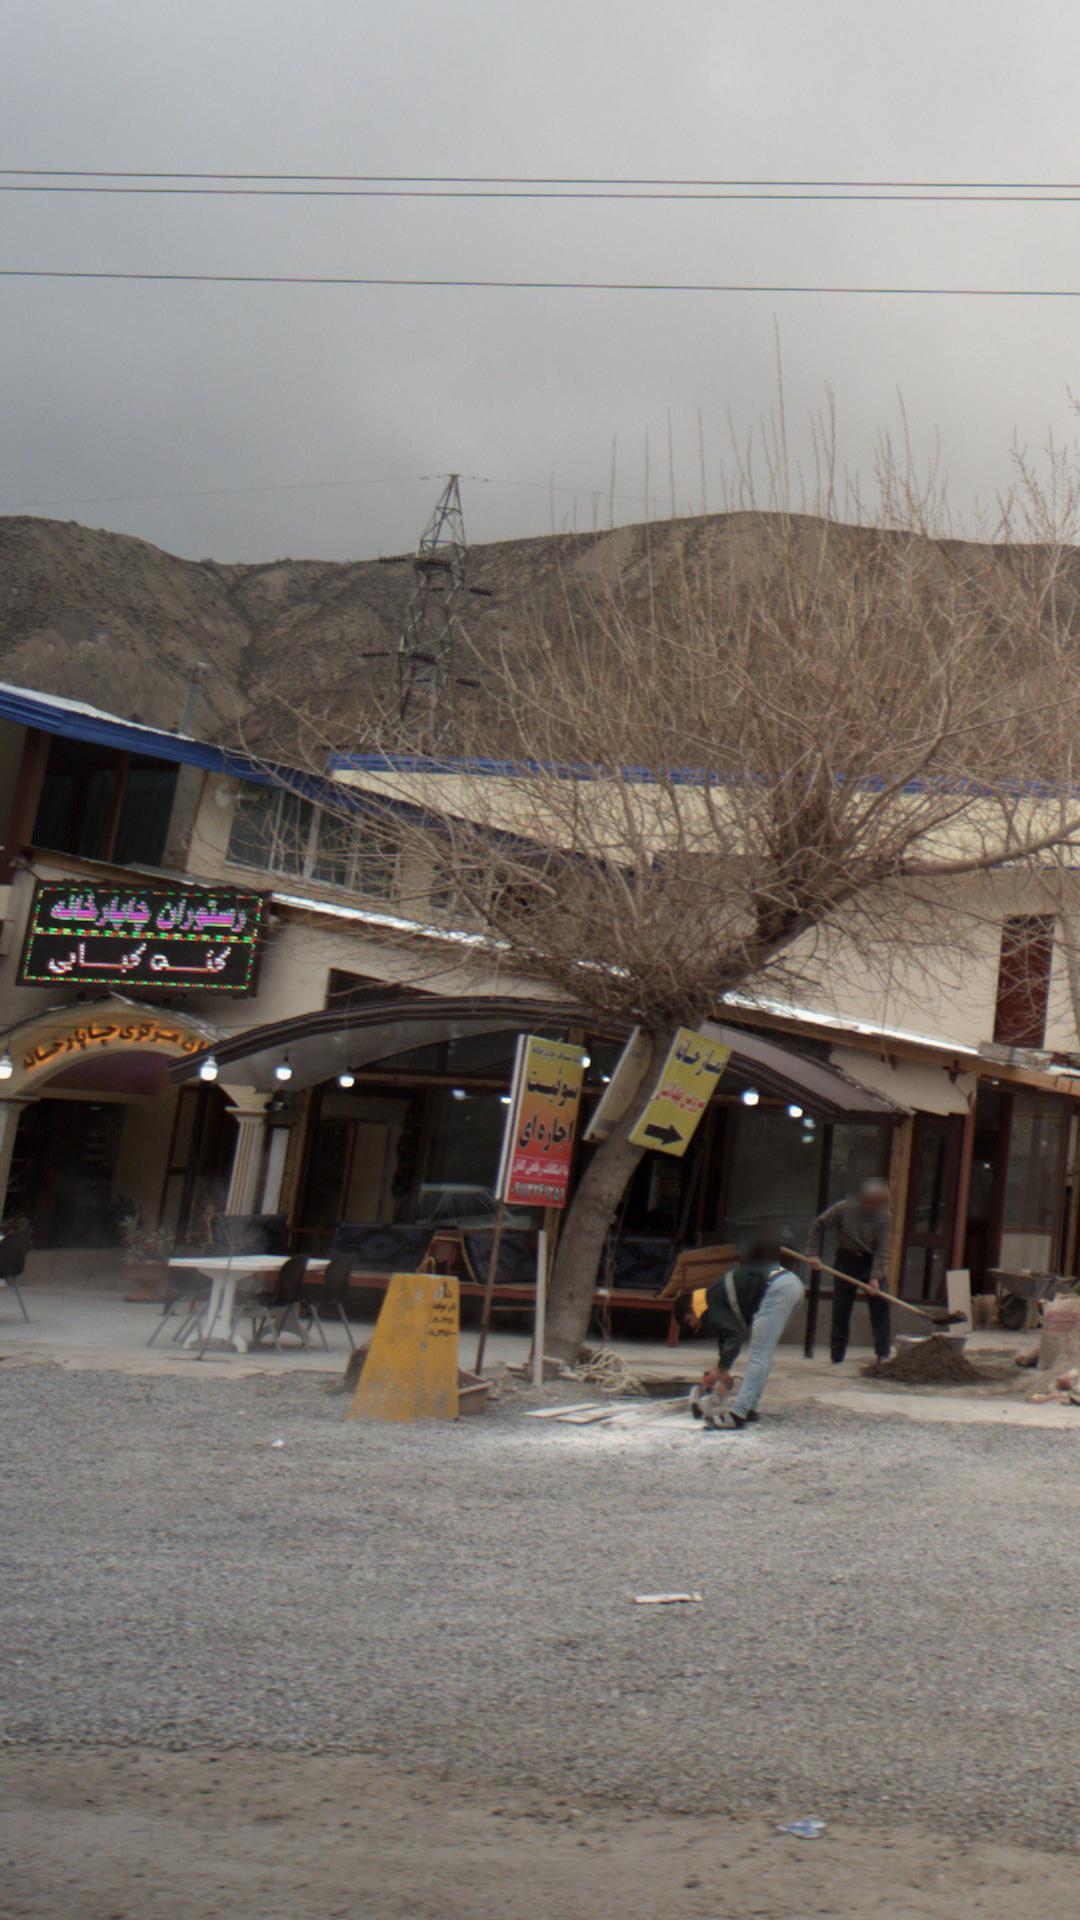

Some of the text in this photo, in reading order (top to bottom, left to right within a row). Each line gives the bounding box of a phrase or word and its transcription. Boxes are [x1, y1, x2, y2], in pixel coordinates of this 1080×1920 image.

[156, 899, 247, 932] رستوران
[48, 943, 147, 974] کبابی
[119, 1023, 178, 1043] مرکزی
